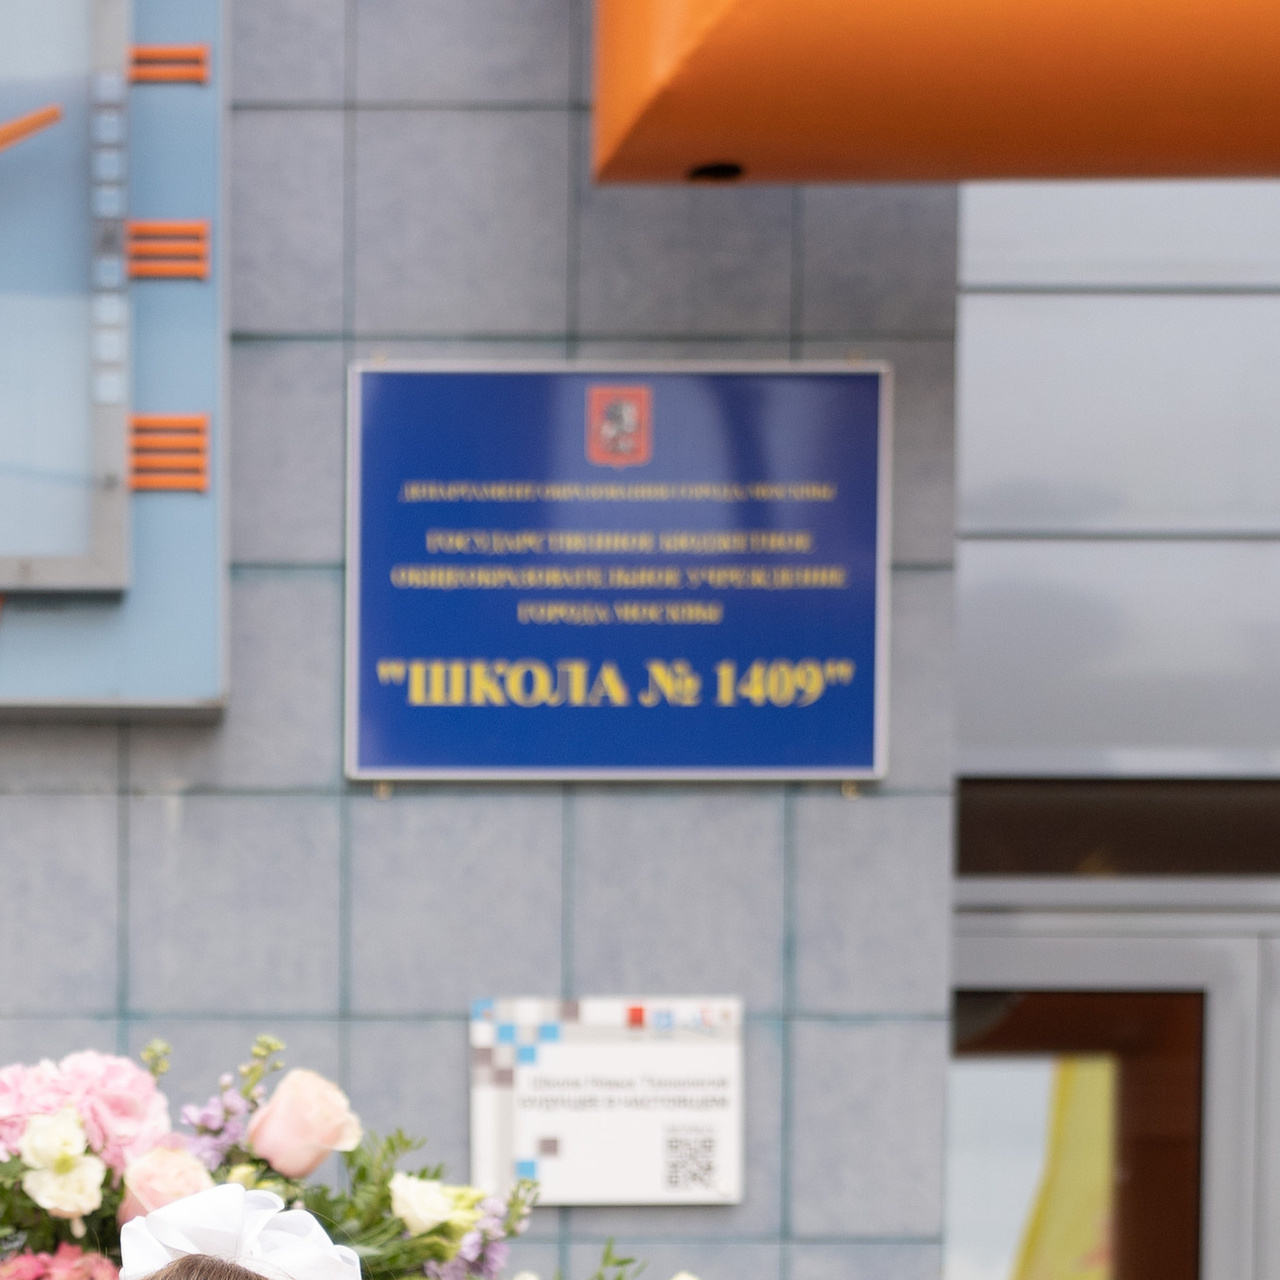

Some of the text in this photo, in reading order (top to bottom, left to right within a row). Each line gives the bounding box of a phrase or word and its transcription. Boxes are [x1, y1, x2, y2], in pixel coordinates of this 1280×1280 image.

[376, 659, 856, 706] "ШКОЛА № 1409"
